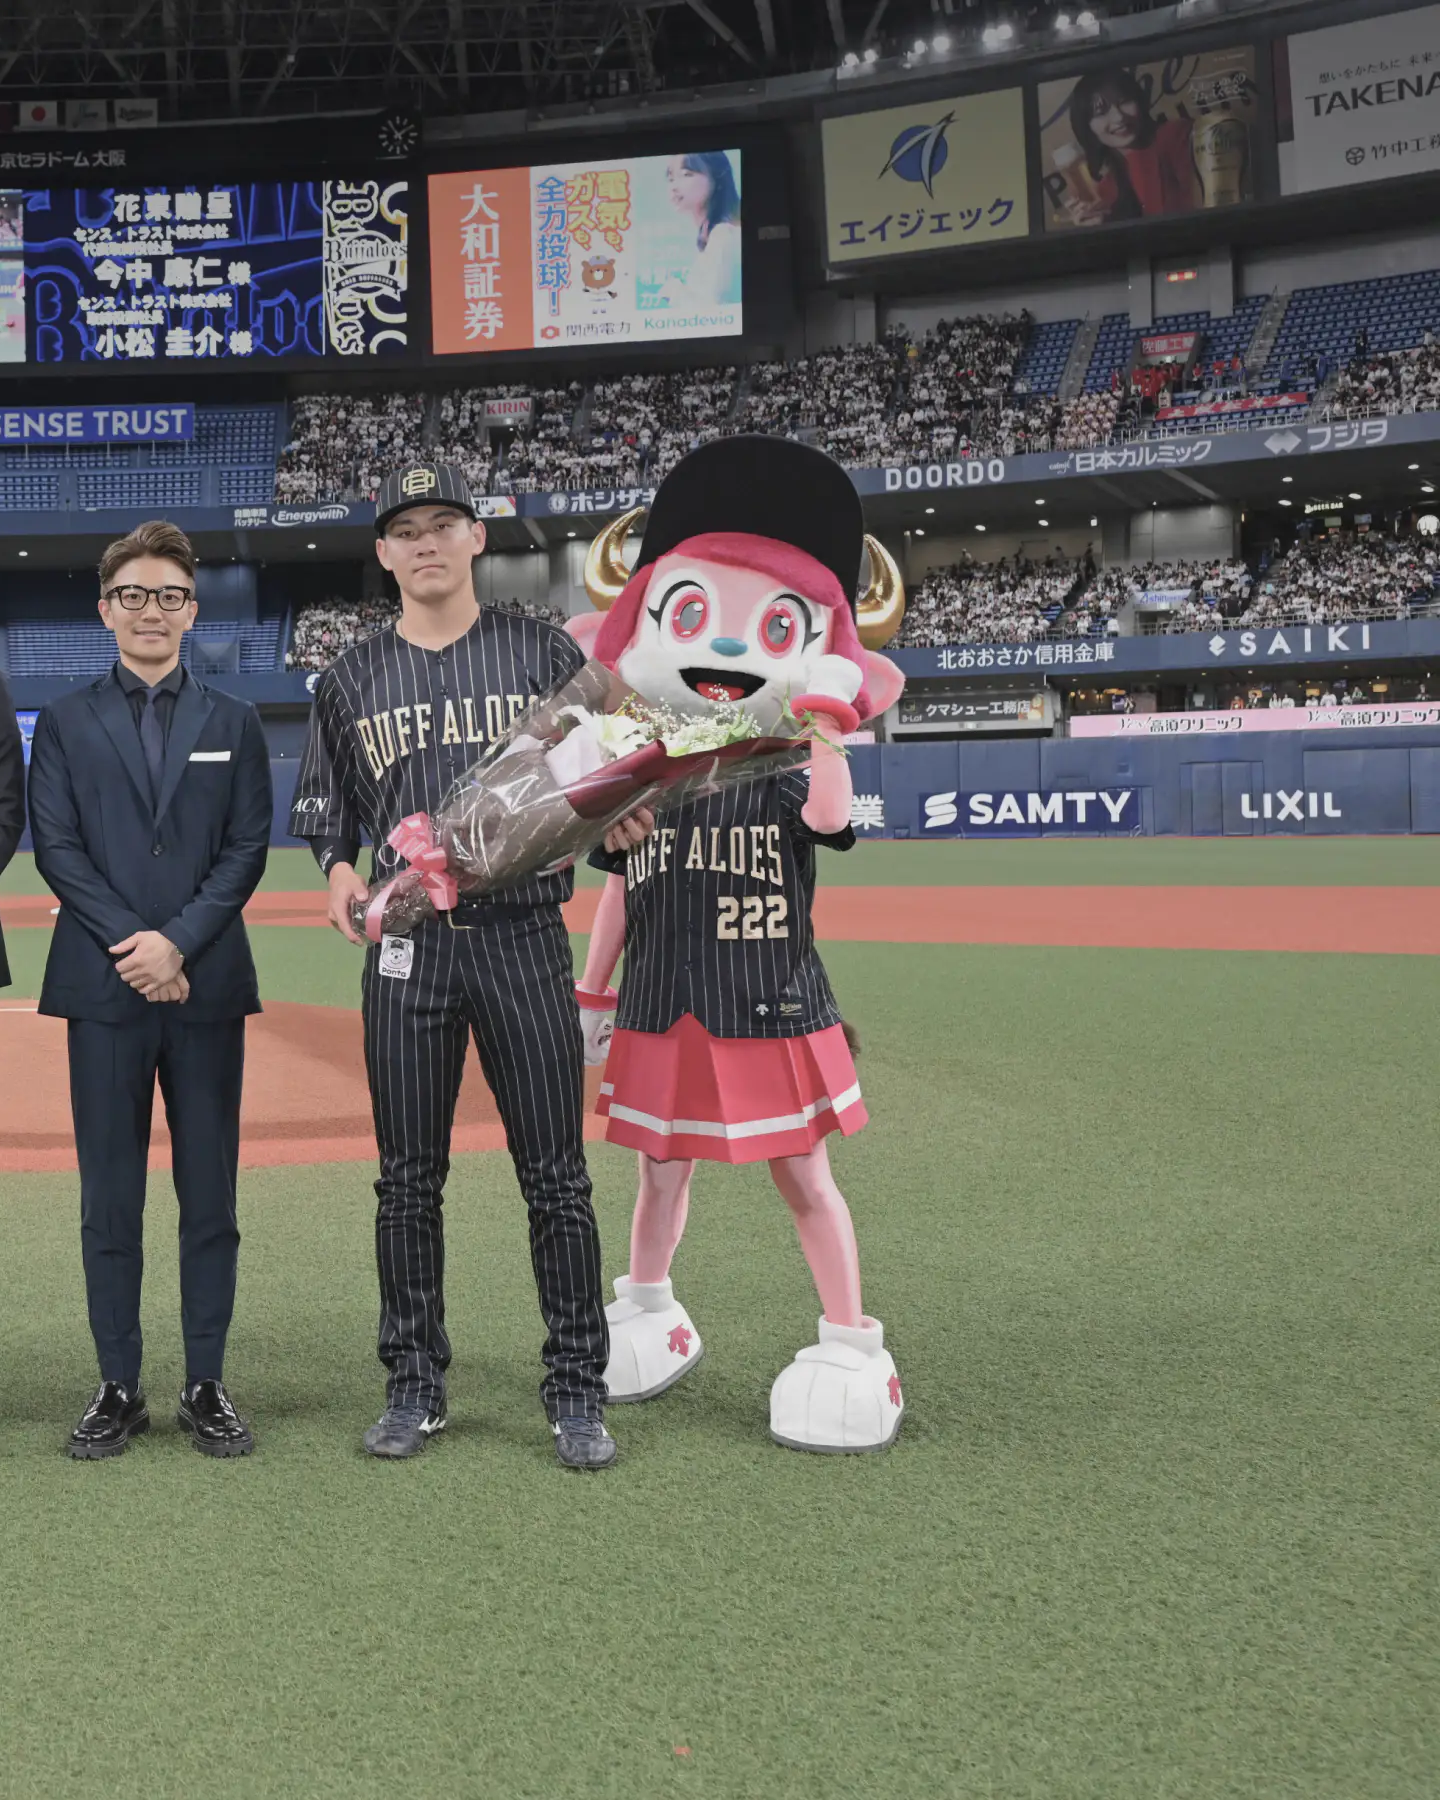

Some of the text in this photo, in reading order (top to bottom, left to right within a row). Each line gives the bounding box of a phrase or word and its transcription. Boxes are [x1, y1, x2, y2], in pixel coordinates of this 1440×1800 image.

[1319, 58, 1402, 84] 想いをかたちに
[0, 149, 126, 168] 京セラドーム 大阪
[839, 197, 1015, 246] エイジェック
[325, 237, 408, 264] Buffaloes
[460, 183, 503, 340] 大和証券
[94, 258, 153, 289] 今中
[228, 261, 252, 285] 様
[565, 320, 631, 340] 関西電力
[643, 311, 735, 330] Kanadevia
[94, 325, 252, 358] 小松 圭介 様
[93, 409, 188, 437] TRUST
[487, 402, 530, 415] KIRIN
[1308, 420, 1388, 450] フジタ
[1075, 440, 1212, 472] 日本カルミック
[885, 459, 1005, 491] DOORDO
[277, 508, 343, 523] Energywith
[1239, 625, 1372, 656] SAIKI
[937, 642, 1116, 670] 北おおさか信用金庫
[925, 700, 1031, 717] クマシュー工務店
[292, 797, 328, 814] ACN
[851, 794, 884, 830] 業
[969, 791, 1132, 825] SAMTY
[1241, 789, 1342, 822] LIXIL
[716, 895, 789, 940] 222
